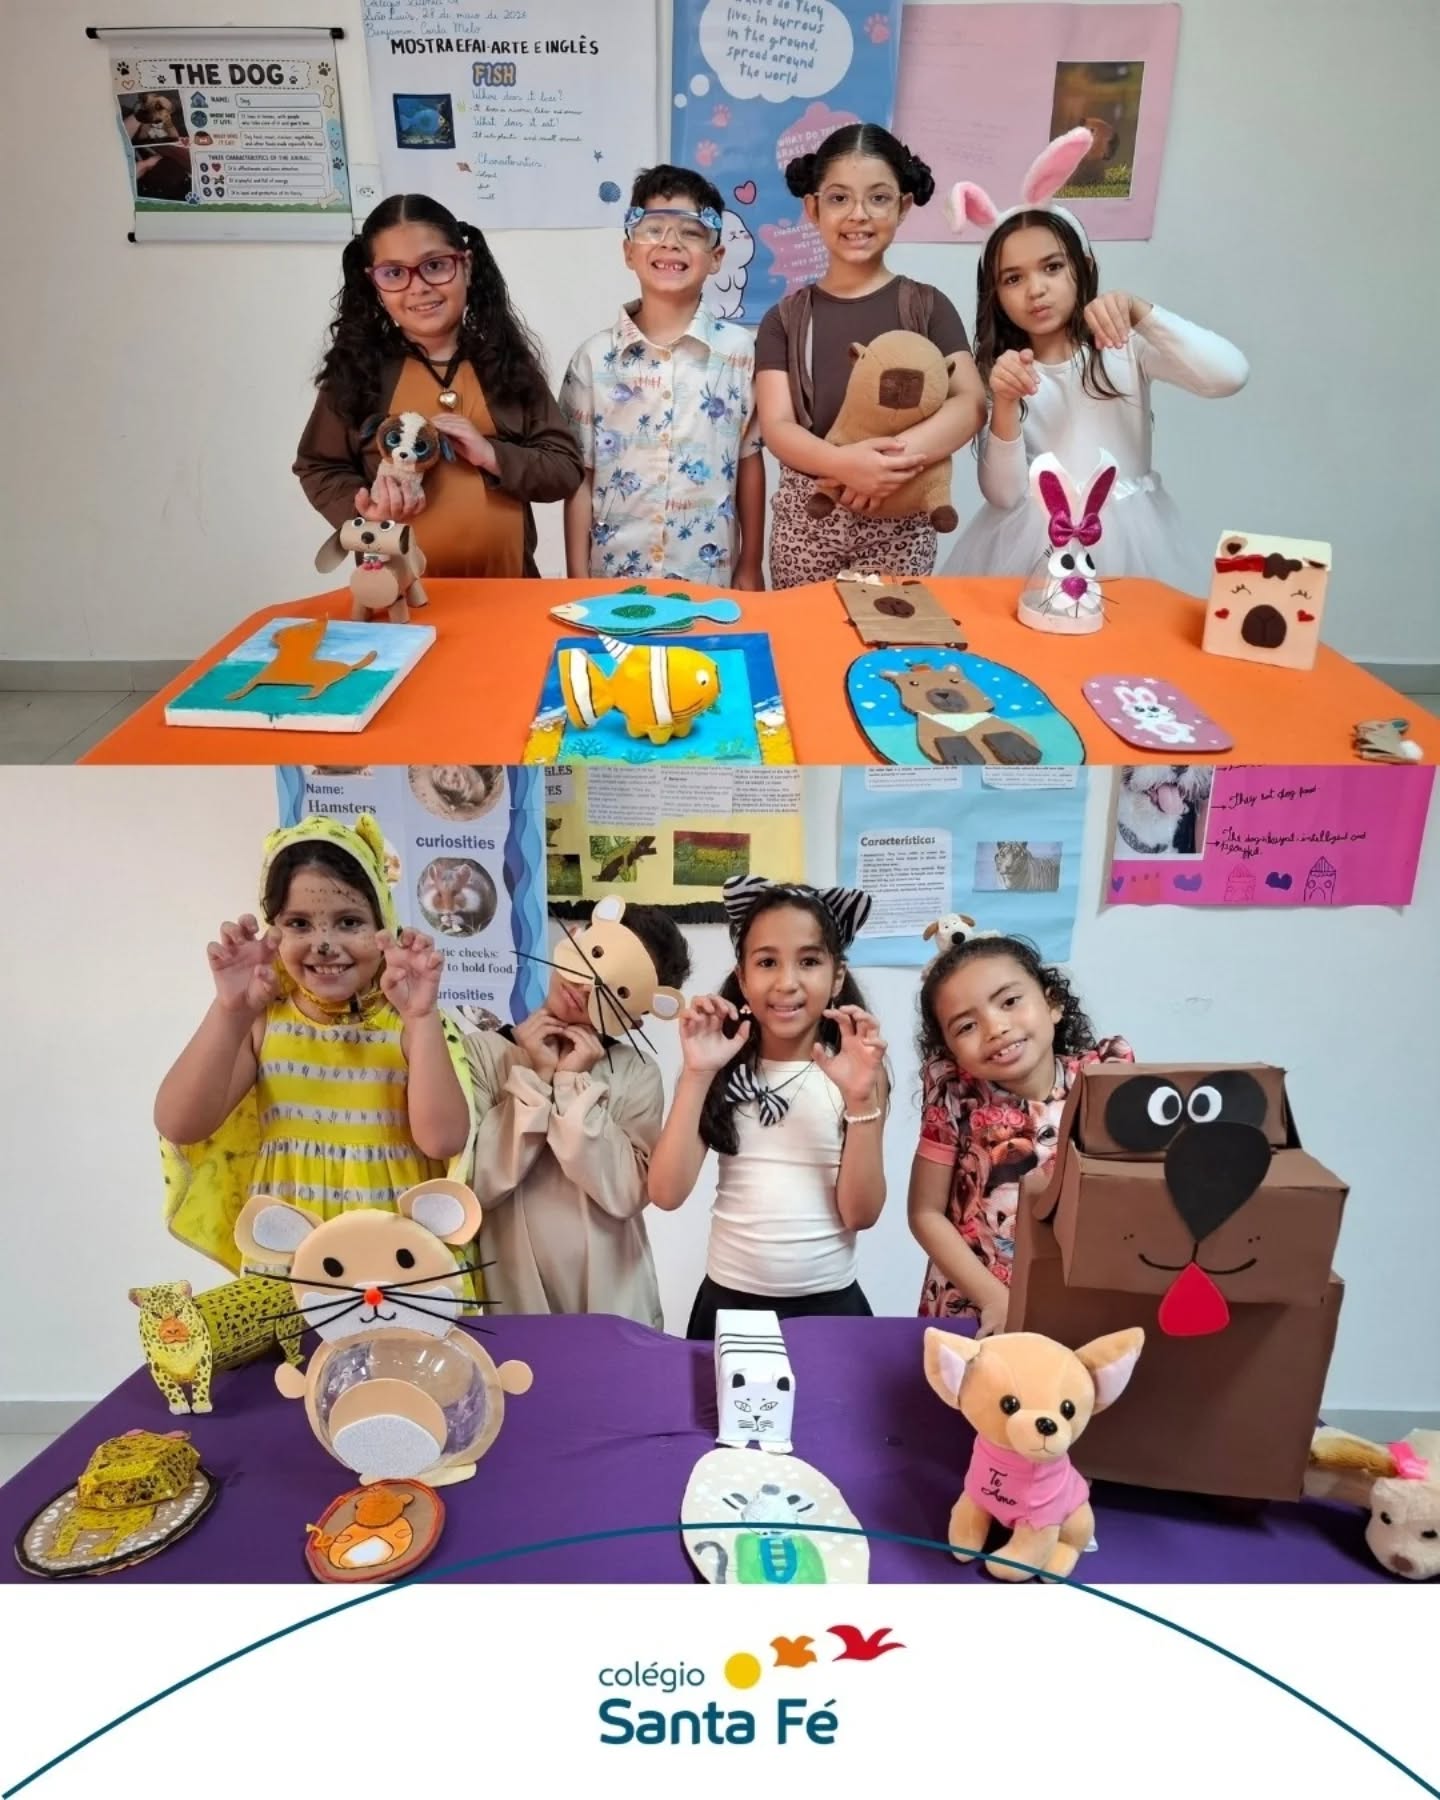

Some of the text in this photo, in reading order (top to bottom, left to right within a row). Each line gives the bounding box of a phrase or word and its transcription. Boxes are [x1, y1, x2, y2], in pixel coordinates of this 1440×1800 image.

[756, 10, 768, 26] in
[772, 14, 824, 34] burrows
[727, 27, 738, 40] in
[391, 38, 452, 55] MOSTRA
[534, 41, 541, 54] E
[545, 35, 599, 55] INGLÊS
[726, 46, 814, 69] spread around
[169, 63, 285, 85] THE DOG
[472, 61, 516, 87] FISH
[740, 61, 798, 85] the world
[306, 783, 345, 795] Name:
[309, 799, 377, 814] Hamsters
[1228, 792, 1257, 809] They
[415, 834, 495, 850] curiosities
[861, 836, 936, 847] Características
[1222, 826, 1241, 842] The
[447, 963, 459, 972] to
[462, 962, 485, 973] hold
[437, 988, 494, 1001] uriosities
[989, 1467, 1008, 1487] Te
[981, 1487, 1018, 1506] Amo
